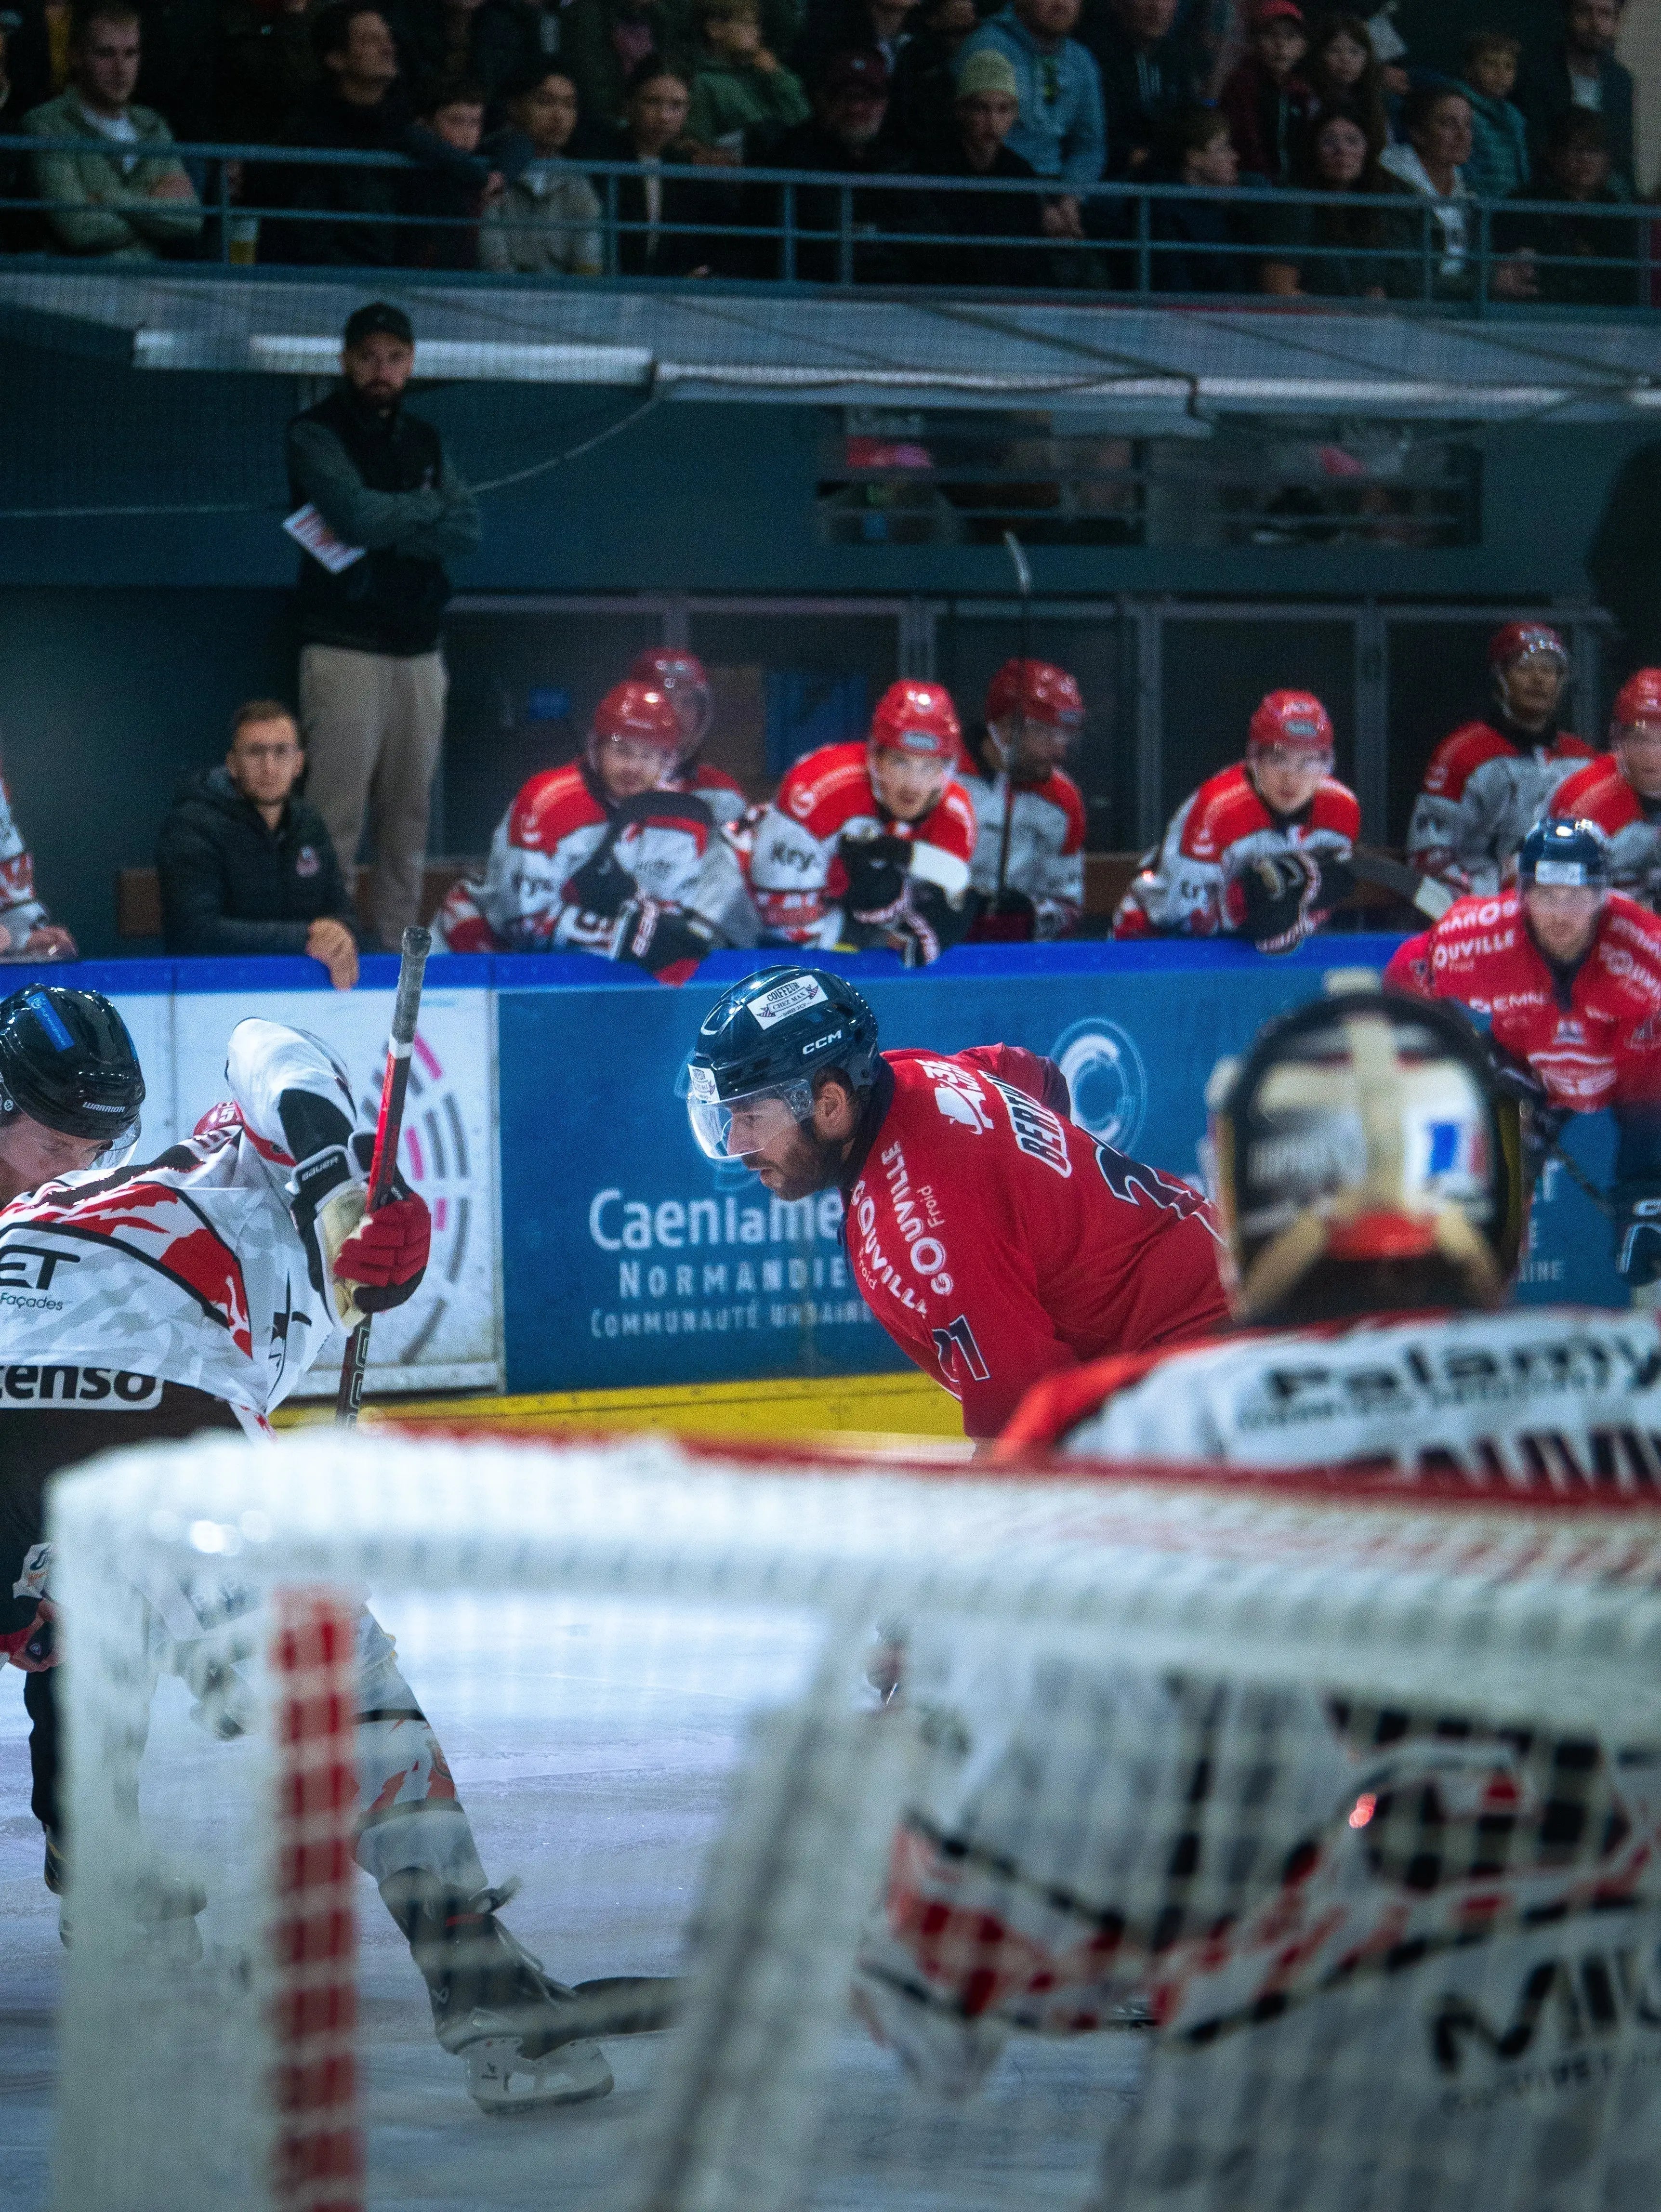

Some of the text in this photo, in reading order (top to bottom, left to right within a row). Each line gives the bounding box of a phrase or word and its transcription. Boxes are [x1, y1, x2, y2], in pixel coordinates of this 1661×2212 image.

[767, 982, 800, 1001] COIFFEUR
[772, 999, 791, 1010] CHEZ
[803, 1029, 842, 1055] CCM
[82, 1101, 125, 1113] WARRIOR
[917, 1185, 946, 1228] Froid
[881, 1140, 954, 1296] GOUVILLE
[0, 1292, 63, 1311] Façades
[0, 1365, 157, 1403] enso
